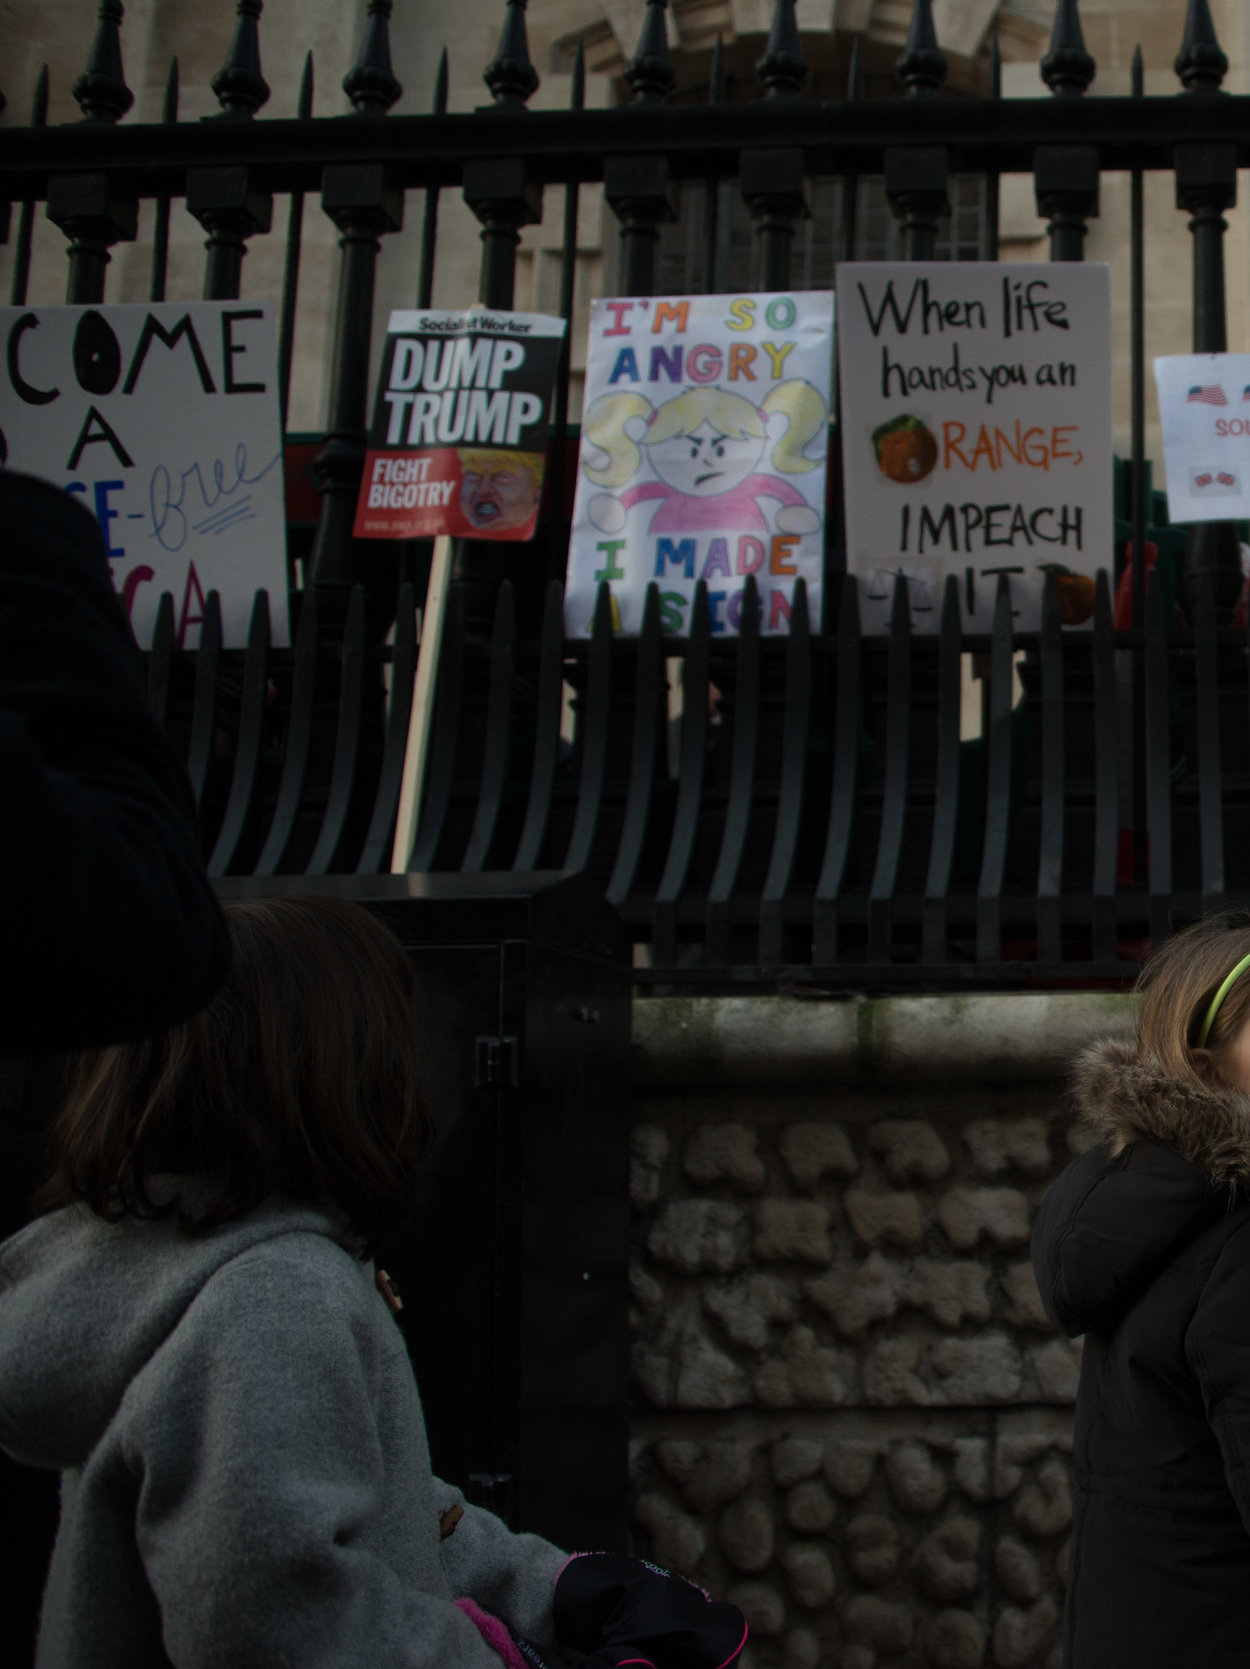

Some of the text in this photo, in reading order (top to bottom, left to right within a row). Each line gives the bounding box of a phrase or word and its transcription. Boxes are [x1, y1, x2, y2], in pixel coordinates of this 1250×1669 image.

[479, 316, 533, 333] Worker
[602, 297, 798, 339] I'M SO
[857, 276, 1070, 338] When life
[7, 309, 266, 405] COME
[388, 337, 526, 392] DUMP
[608, 341, 798, 385] ANGRY
[881, 344, 1076, 402] hands you an
[67, 406, 135, 470] A
[384, 389, 543, 446] TRUMP
[367, 481, 456, 509] BIGOTRY
[372, 457, 432, 484] FIGHT
[900, 503, 1083, 553] IMPEACH
[594, 535, 802, 581] I MADE
